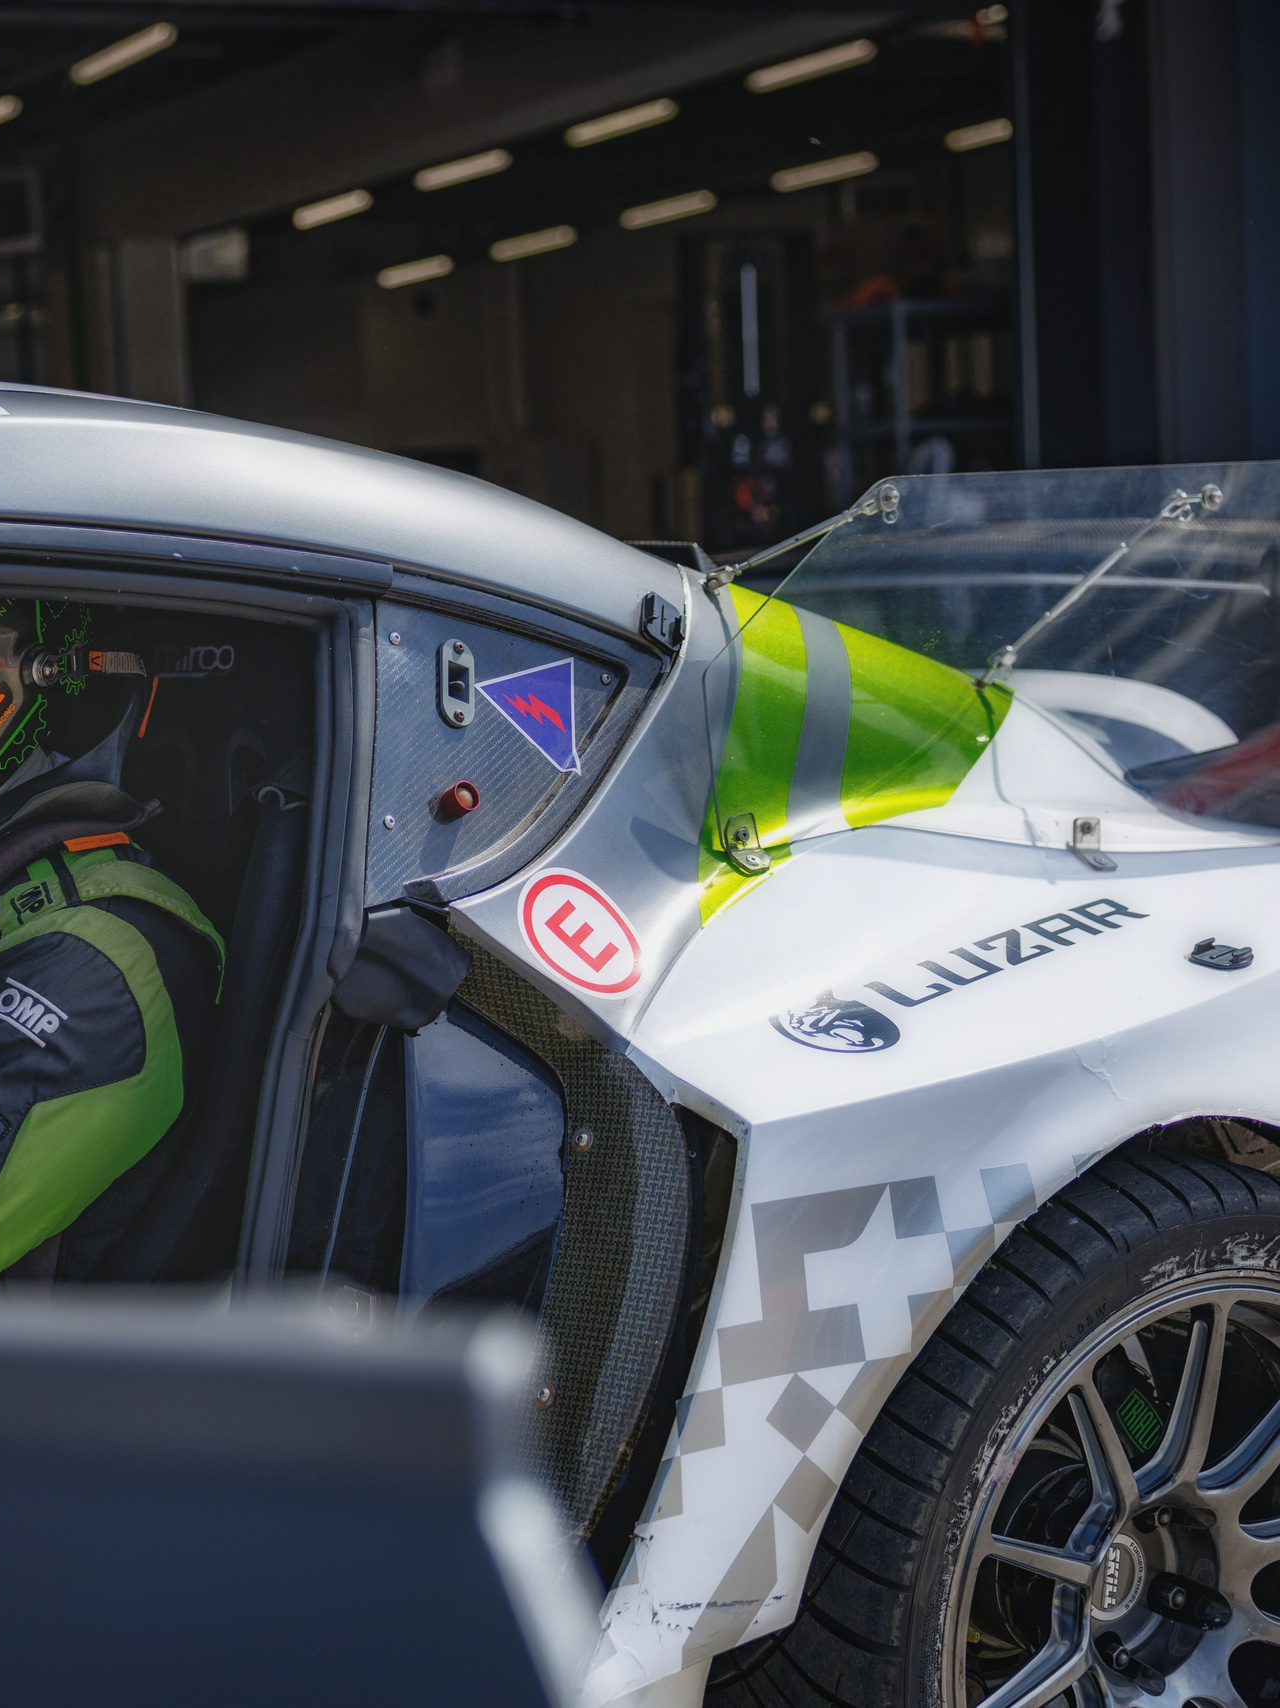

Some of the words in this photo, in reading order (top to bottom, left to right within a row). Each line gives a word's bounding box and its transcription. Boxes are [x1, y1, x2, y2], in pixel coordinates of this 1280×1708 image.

[544, 900, 619, 973] E
[862, 897, 1151, 1008] LUZAR
[1102, 1545, 1121, 1610] SKILL
[1129, 1541, 1144, 1573] FORGED
[1124, 1575, 1143, 1611] WHEELS
